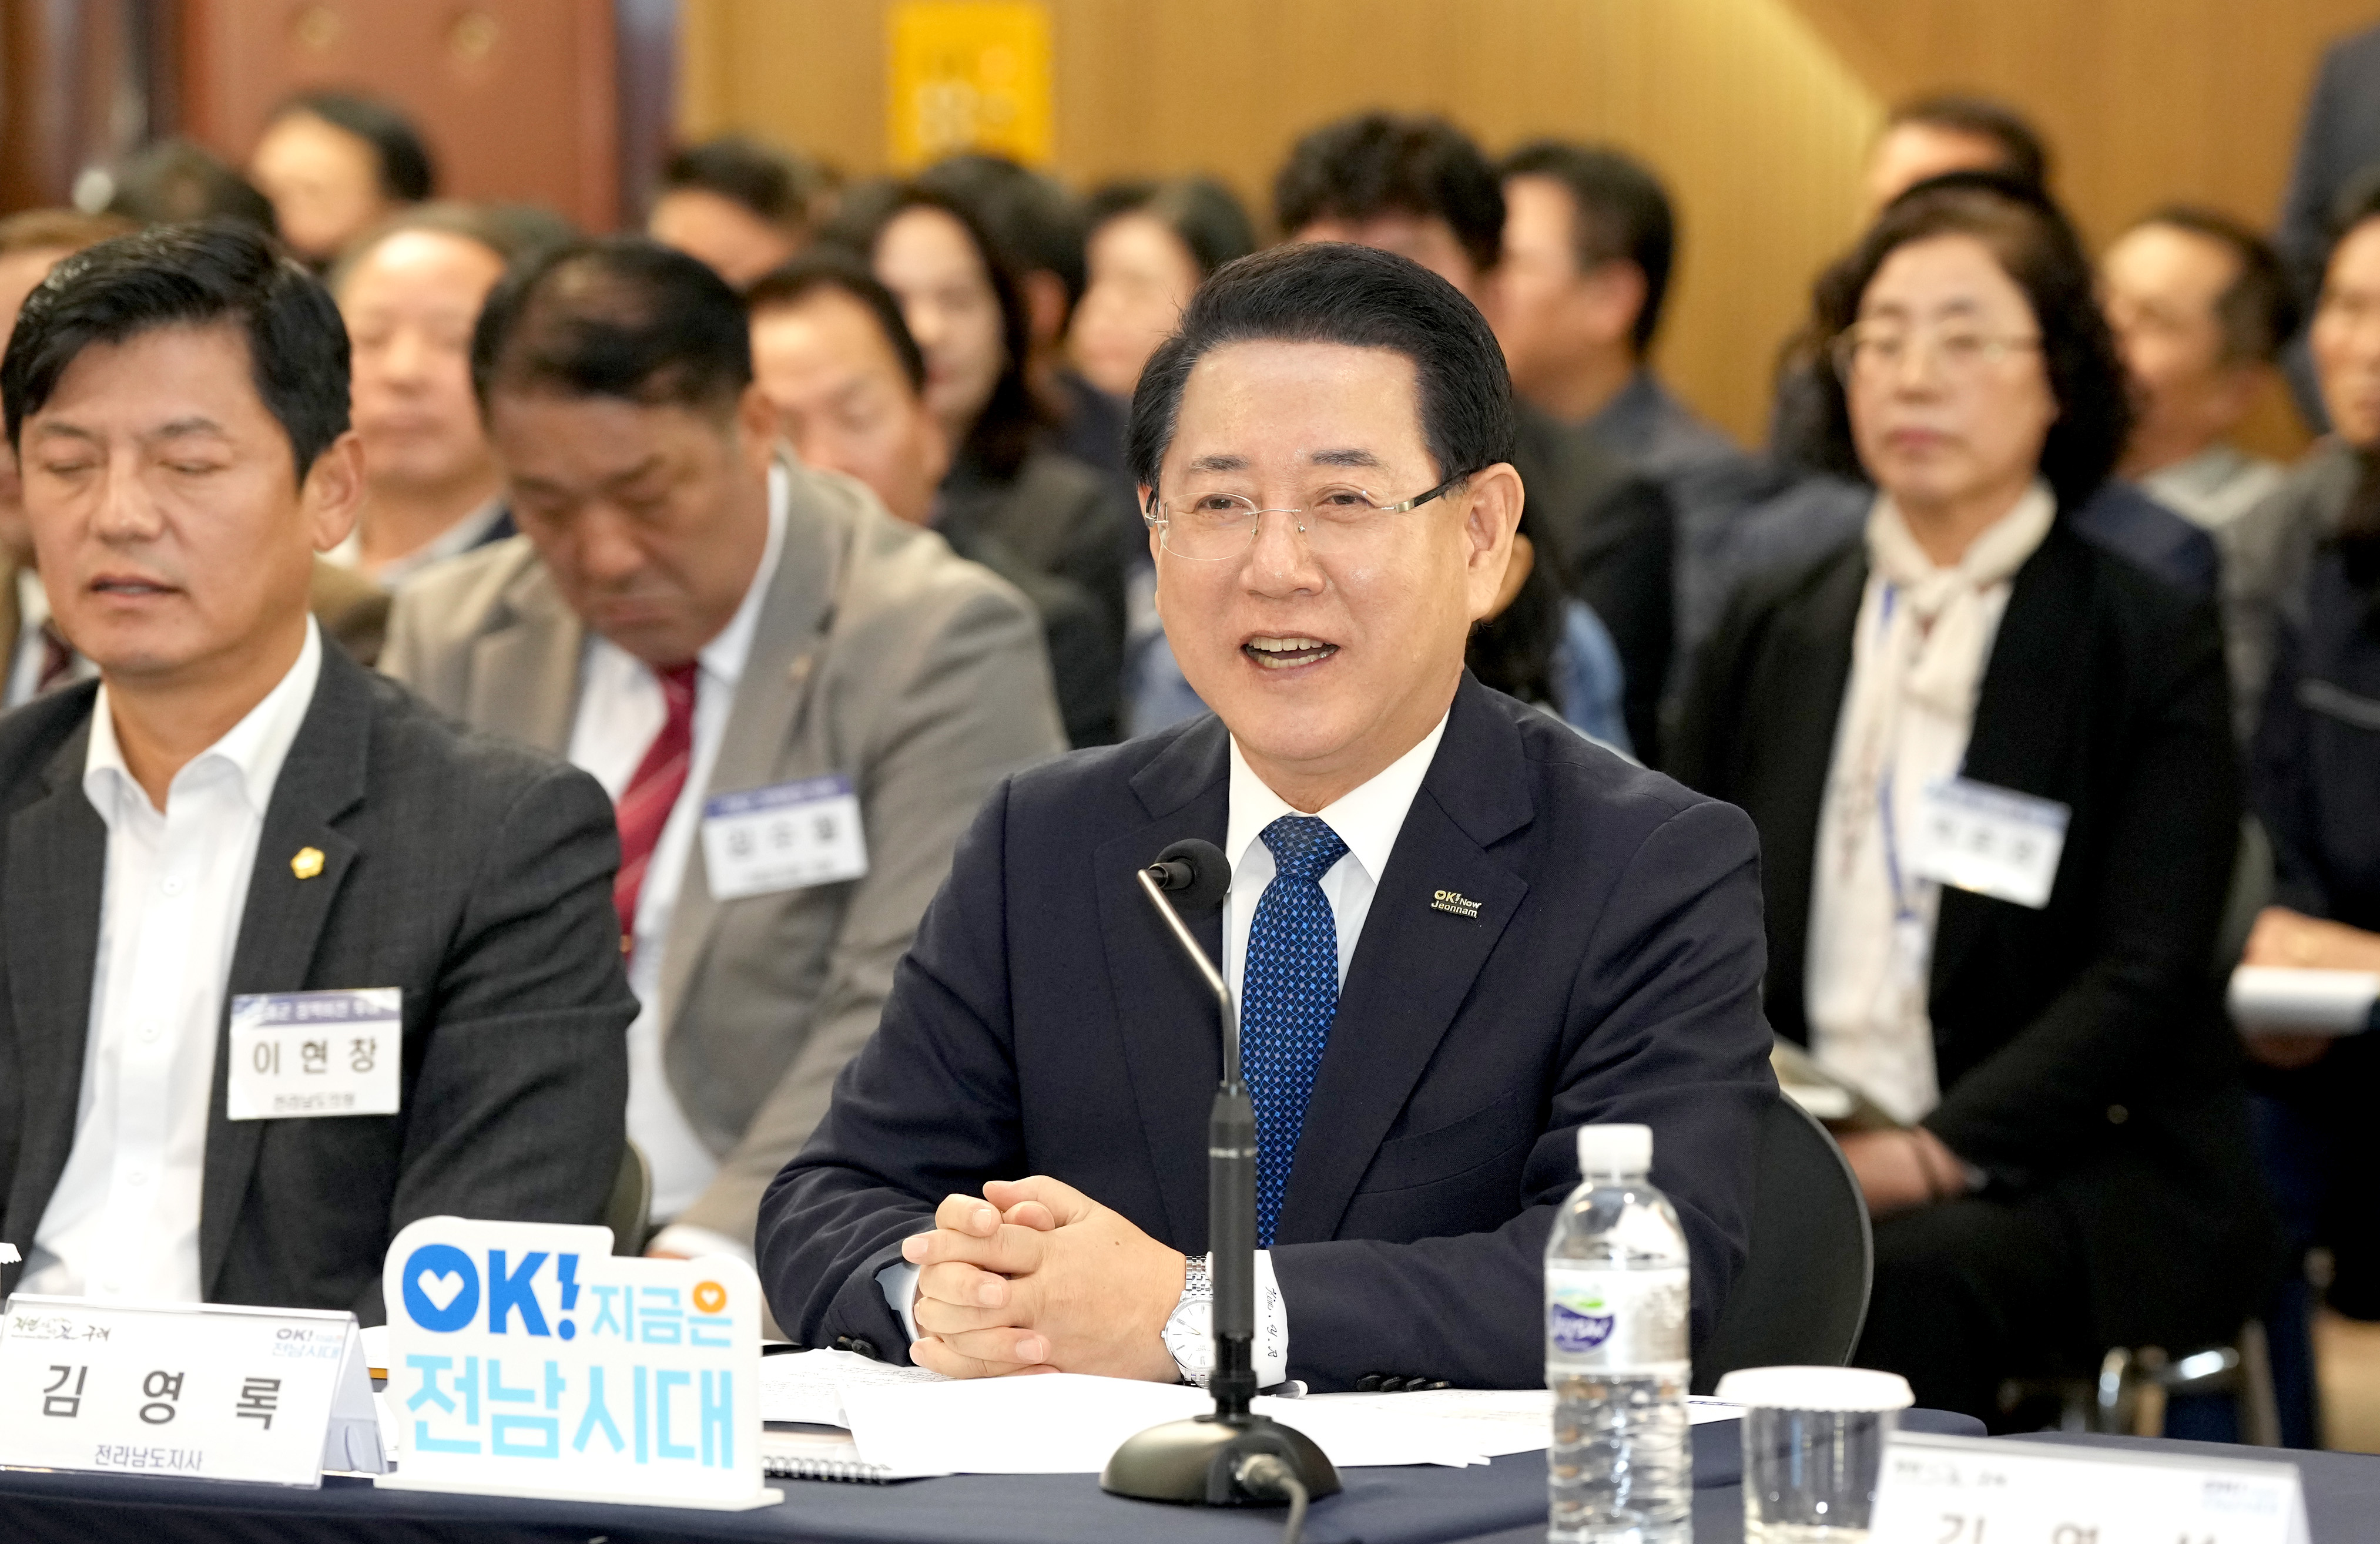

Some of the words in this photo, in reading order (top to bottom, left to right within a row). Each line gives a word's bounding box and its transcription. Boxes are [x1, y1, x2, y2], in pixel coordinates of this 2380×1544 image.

[1431, 901, 1477, 918] Jeonnam
[1434, 890, 1461, 904] OK!
[1459, 898, 1481, 909] Now
[402, 1243, 581, 1341] OK!
[591, 1280, 733, 1347] 지금은
[405, 1353, 734, 1470] 전남시대
[94, 1444, 204, 1472] 전라남도지사
